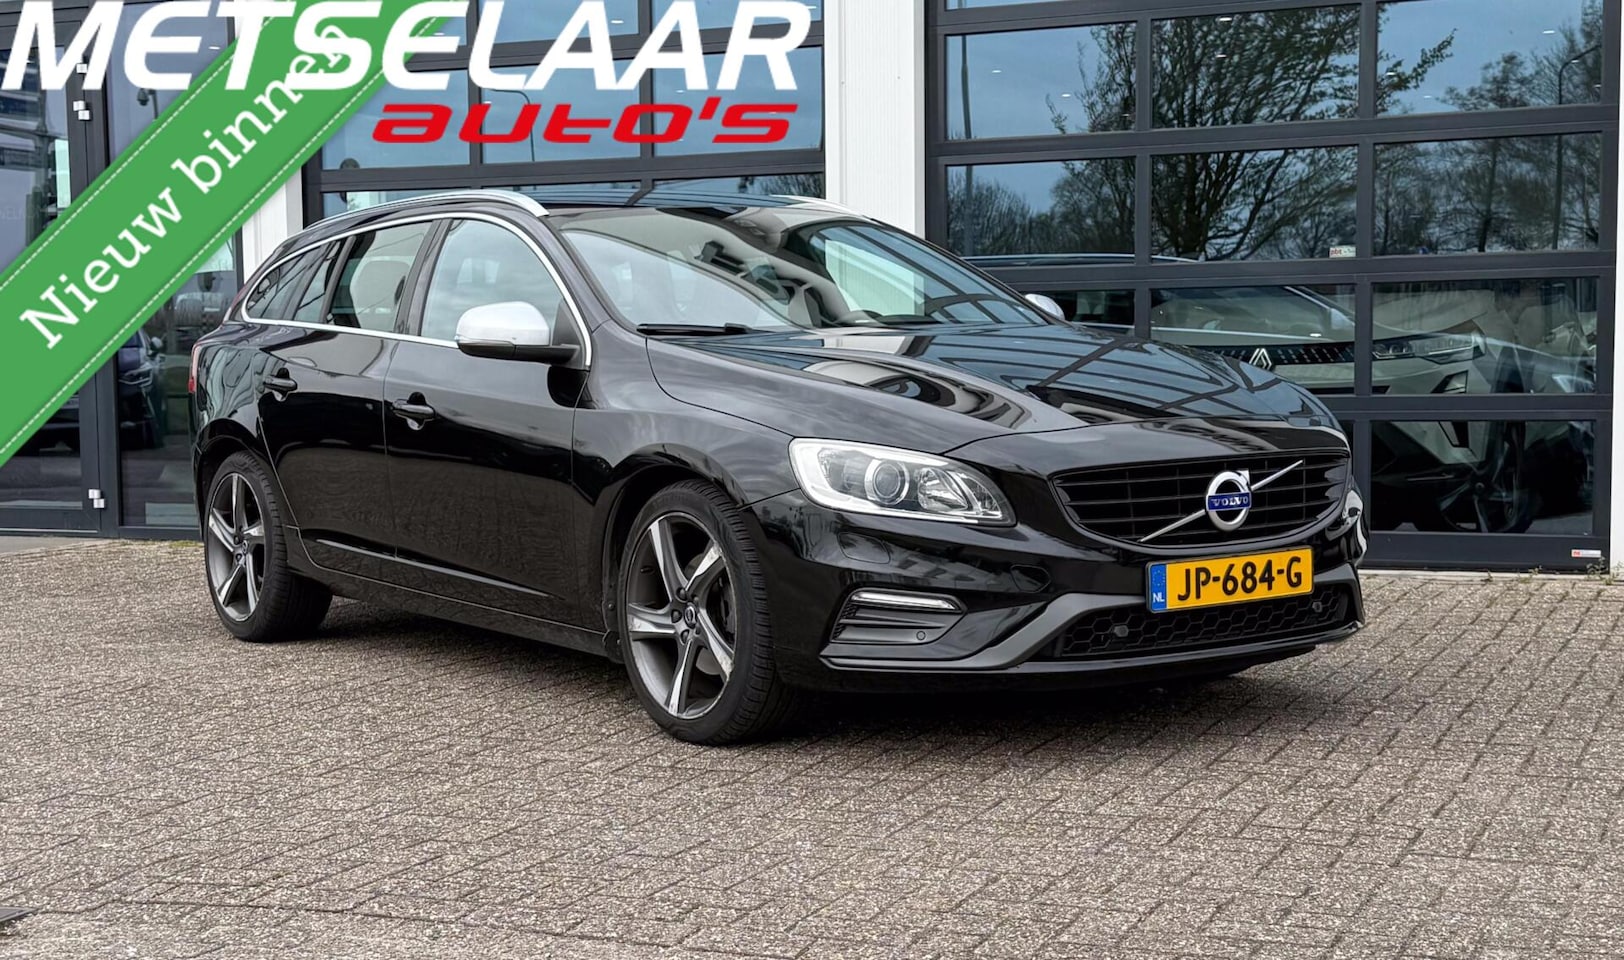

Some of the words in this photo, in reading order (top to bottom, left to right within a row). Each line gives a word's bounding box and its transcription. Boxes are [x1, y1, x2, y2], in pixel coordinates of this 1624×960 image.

[1210, 496, 1249, 507] VOLVO
[1152, 592, 1165, 602] NL
[1177, 556, 1302, 601] JP-684-G
